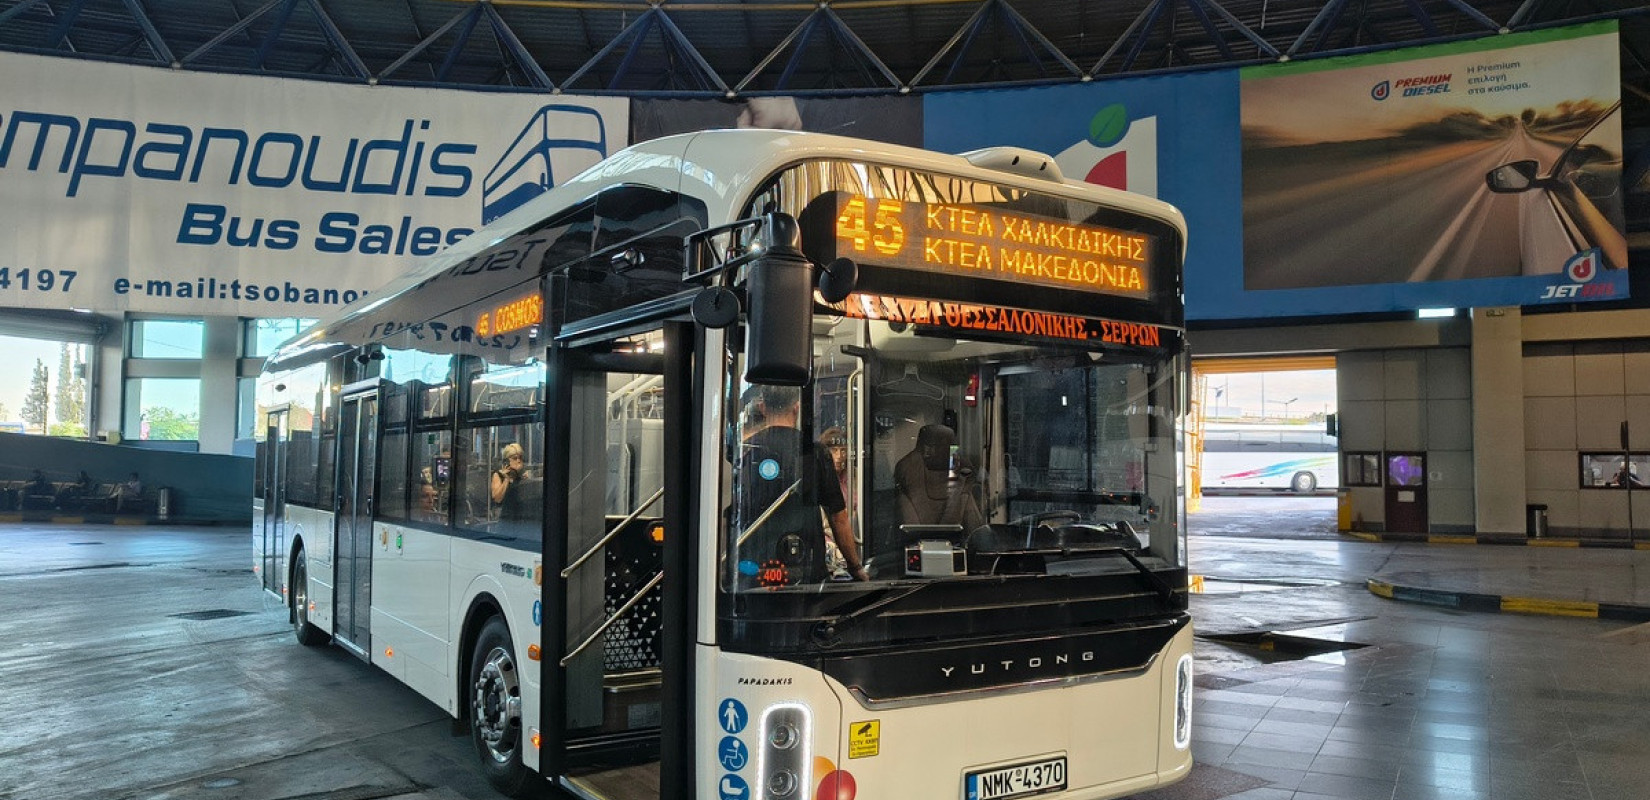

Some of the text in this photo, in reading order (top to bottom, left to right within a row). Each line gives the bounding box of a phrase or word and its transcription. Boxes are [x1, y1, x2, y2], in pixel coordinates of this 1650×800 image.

[1395, 74, 1452, 88] PREMIUM
[1477, 61, 1520, 73] Premium
[1402, 84, 1452, 97] DIESEL
[0, 111, 477, 197] mpanoudis
[176, 203, 300, 250] Bus
[836, 195, 904, 254] 45
[927, 204, 1145, 261] ΚΤΕΛ ΧΑΛΚΙΔΙΚΗΣ
[925, 237, 1142, 290] ΚΤΕΛ ΜΑΚΕΔΟΝΙΑ
[114, 277, 368, 305] e-mail:tsobano
[944, 302, 1088, 340] ΘΕΣΣΑΛΟΝΙΚΗΣ
[1101, 320, 1159, 347] ΣΕΡΡΩΝ
[764, 570, 782, 582] 400
[941, 651, 1094, 677] YUTONG
[738, 677, 793, 686] PAPADAKIS
